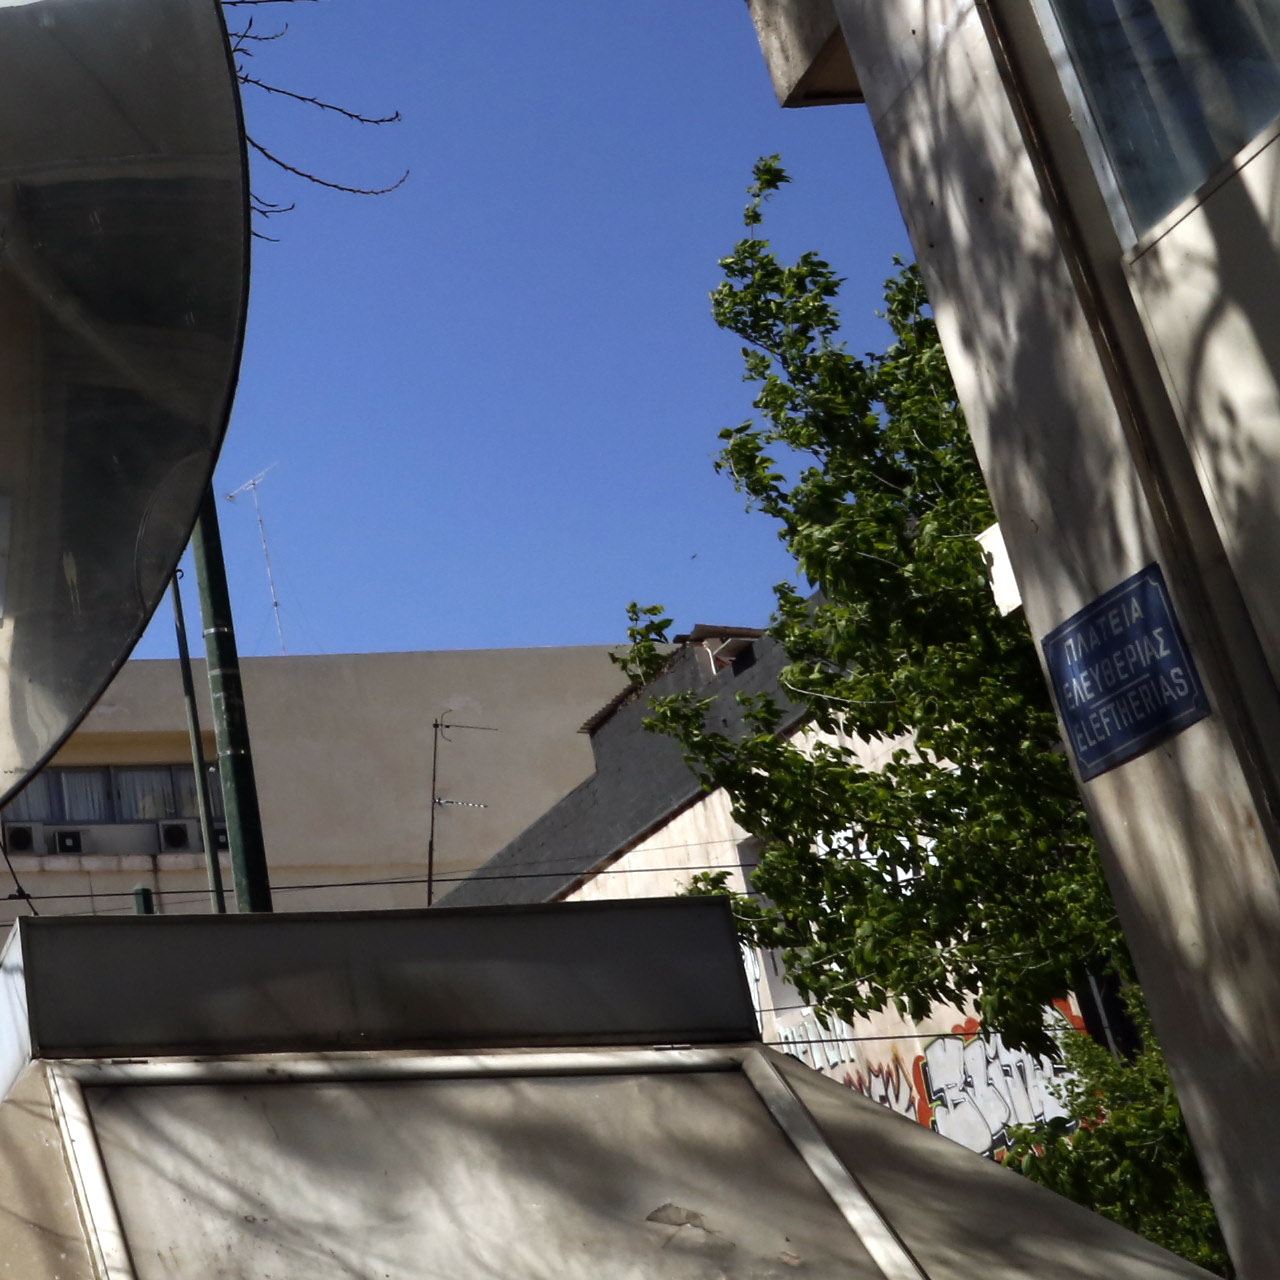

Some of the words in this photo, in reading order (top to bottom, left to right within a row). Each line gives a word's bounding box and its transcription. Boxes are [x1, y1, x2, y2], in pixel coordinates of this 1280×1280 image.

[1063, 627, 1171, 710] ΕΛΕΥΘΕΡΙΑΣ
[1064, 597, 1144, 665] ΠΛΑΤΕΙΑ
[1075, 667, 1189, 752] ELEFTHERIAS
